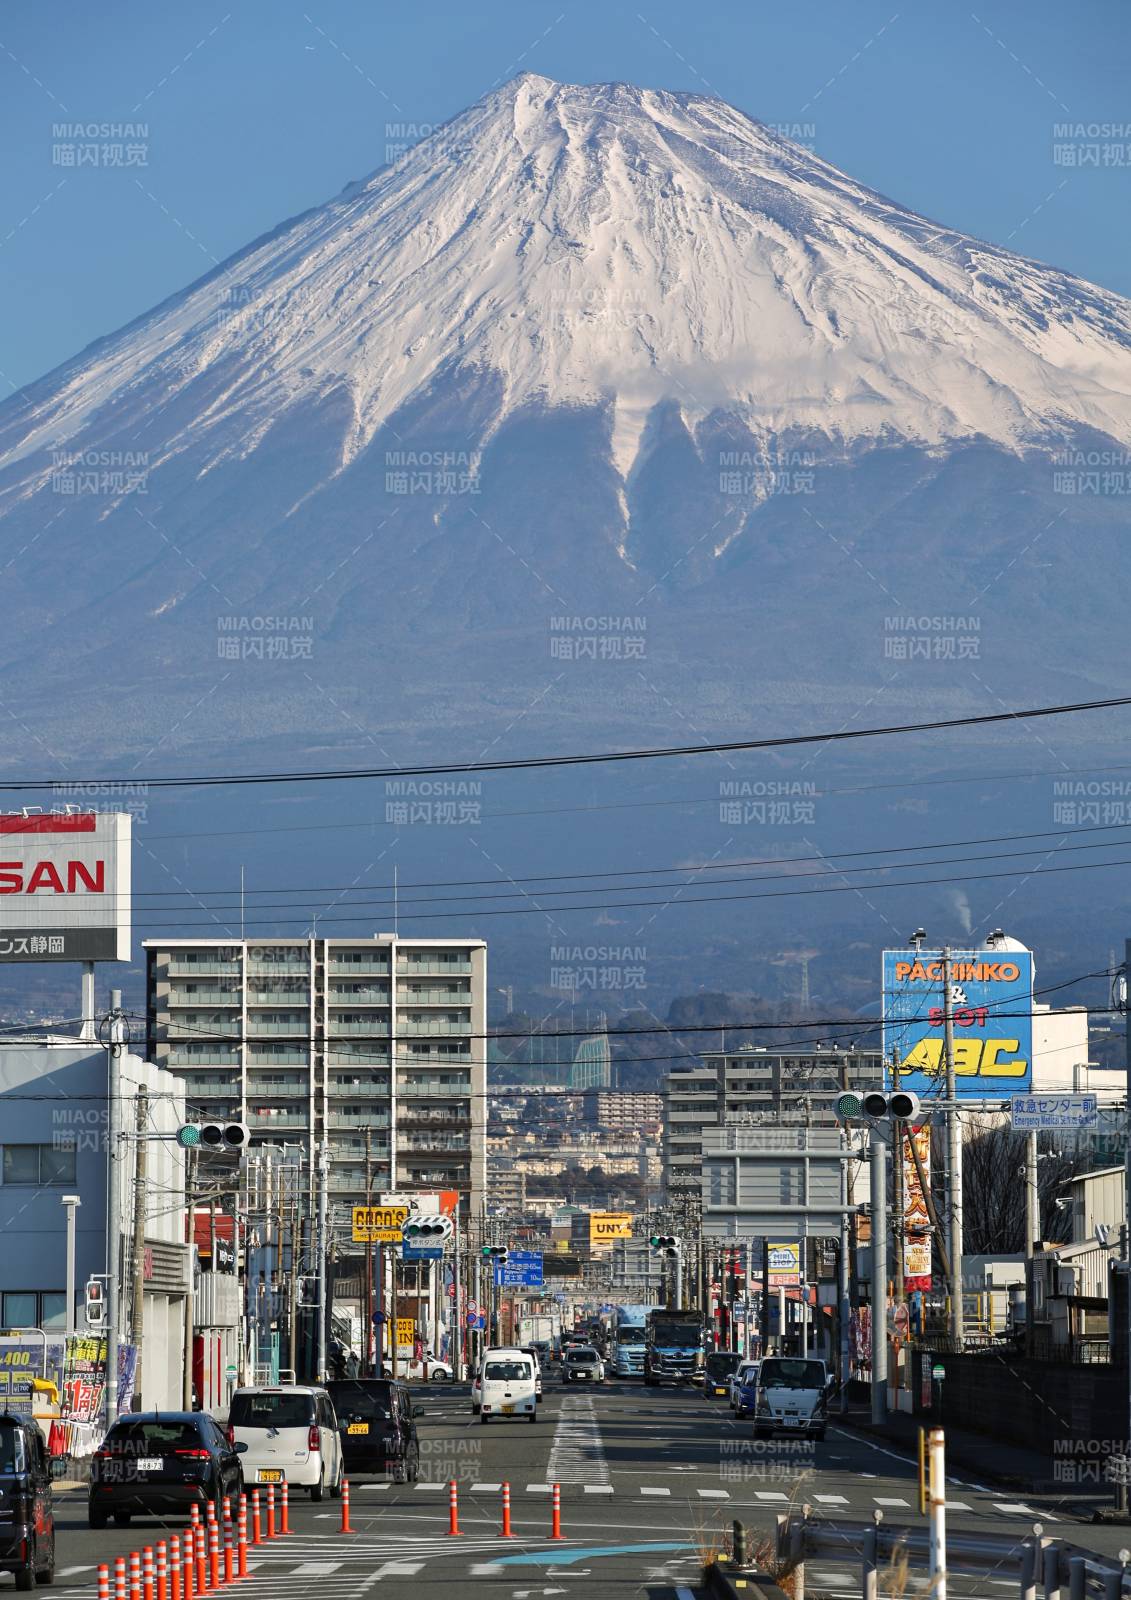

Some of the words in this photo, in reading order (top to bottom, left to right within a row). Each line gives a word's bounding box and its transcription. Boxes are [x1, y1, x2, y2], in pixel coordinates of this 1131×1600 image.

[0, 861, 104, 893] SAN
[928, 1007, 988, 1027] SOT
[888, 1038, 1027, 1077] ABC
[1015, 1099, 1094, 1113] 救急センター前
